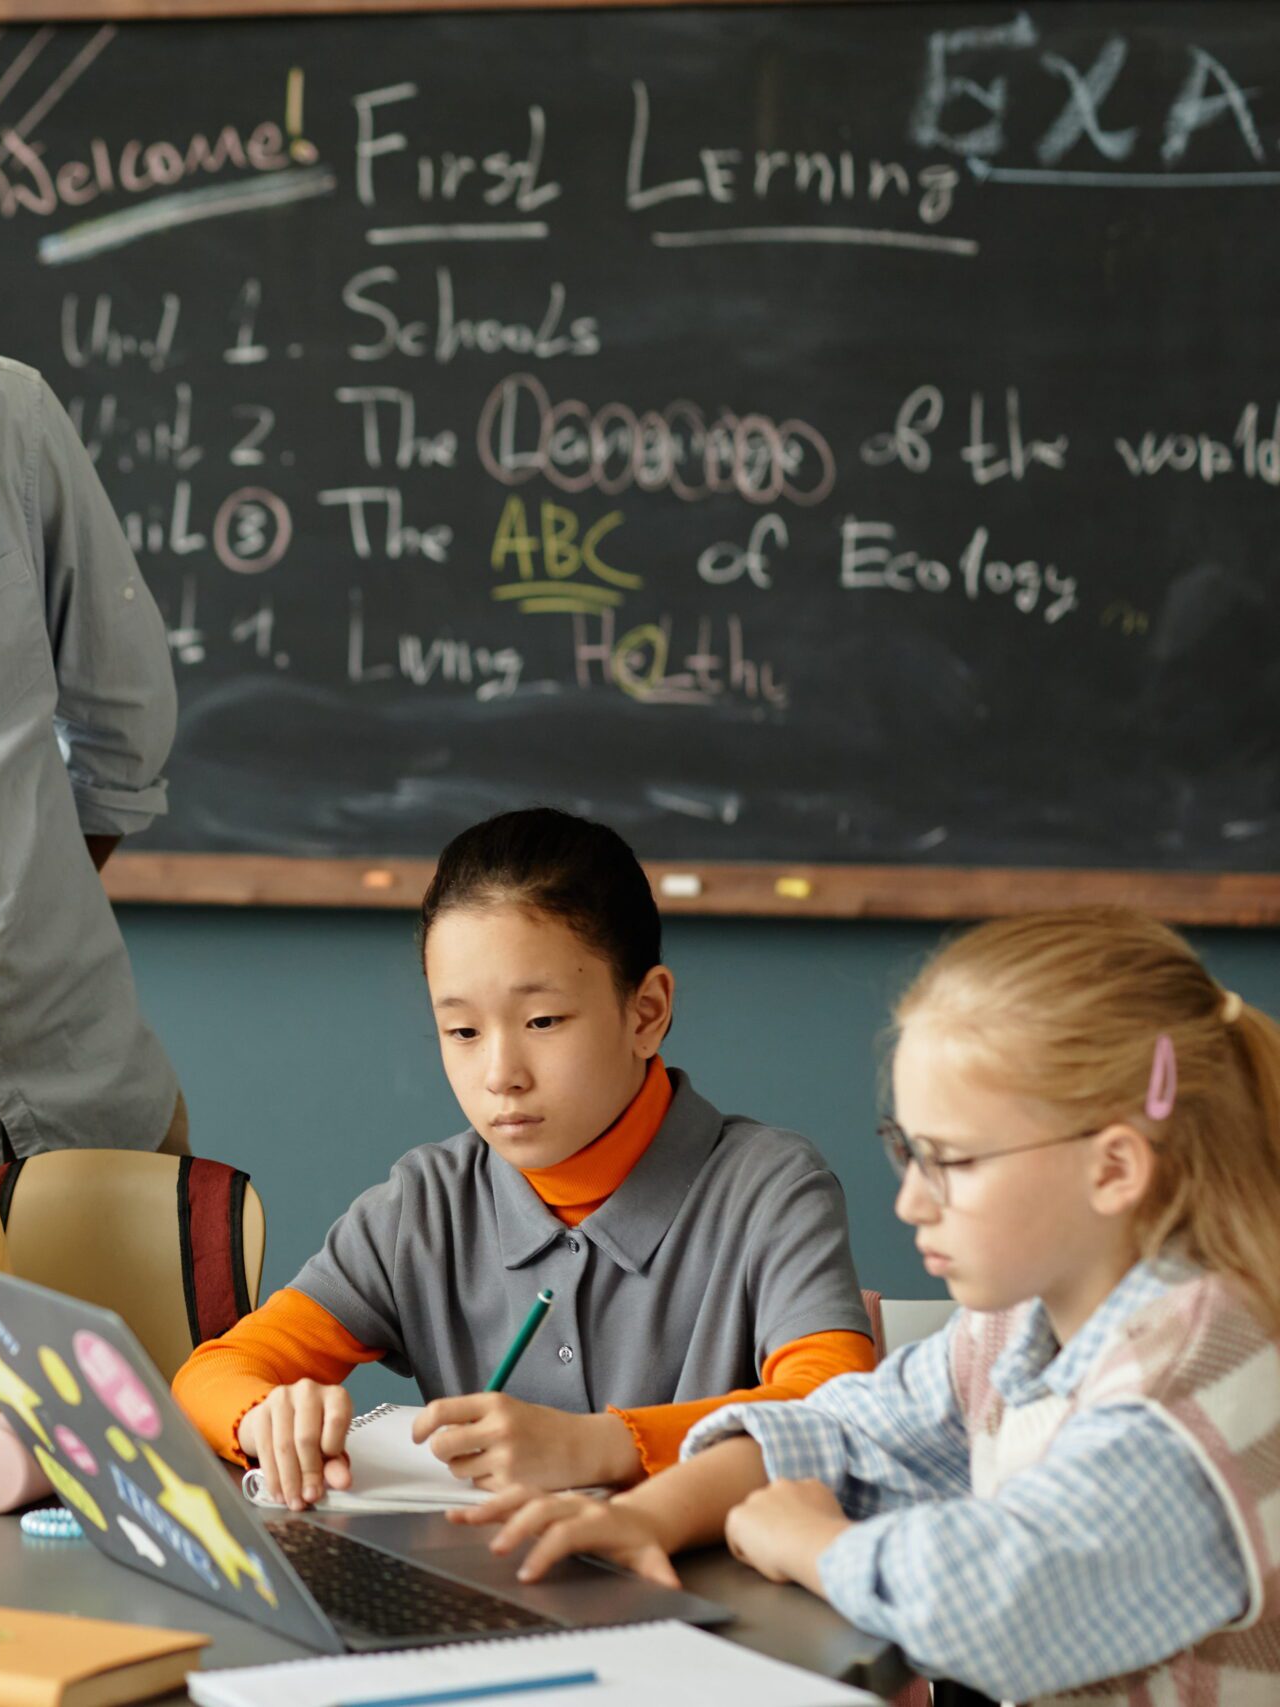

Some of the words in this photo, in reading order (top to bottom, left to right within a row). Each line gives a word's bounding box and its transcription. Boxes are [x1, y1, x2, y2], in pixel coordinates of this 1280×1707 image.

[353, 82, 561, 207] First
[909, 10, 1280, 163] EXA
[335, 386, 459, 469] The
[860, 385, 944, 473] of
[961, 387, 1068, 485] the
[317, 488, 454, 562] The
[491, 496, 643, 590] ABC
[698, 513, 789, 589] of
[840, 518, 1079, 623] Ecology
